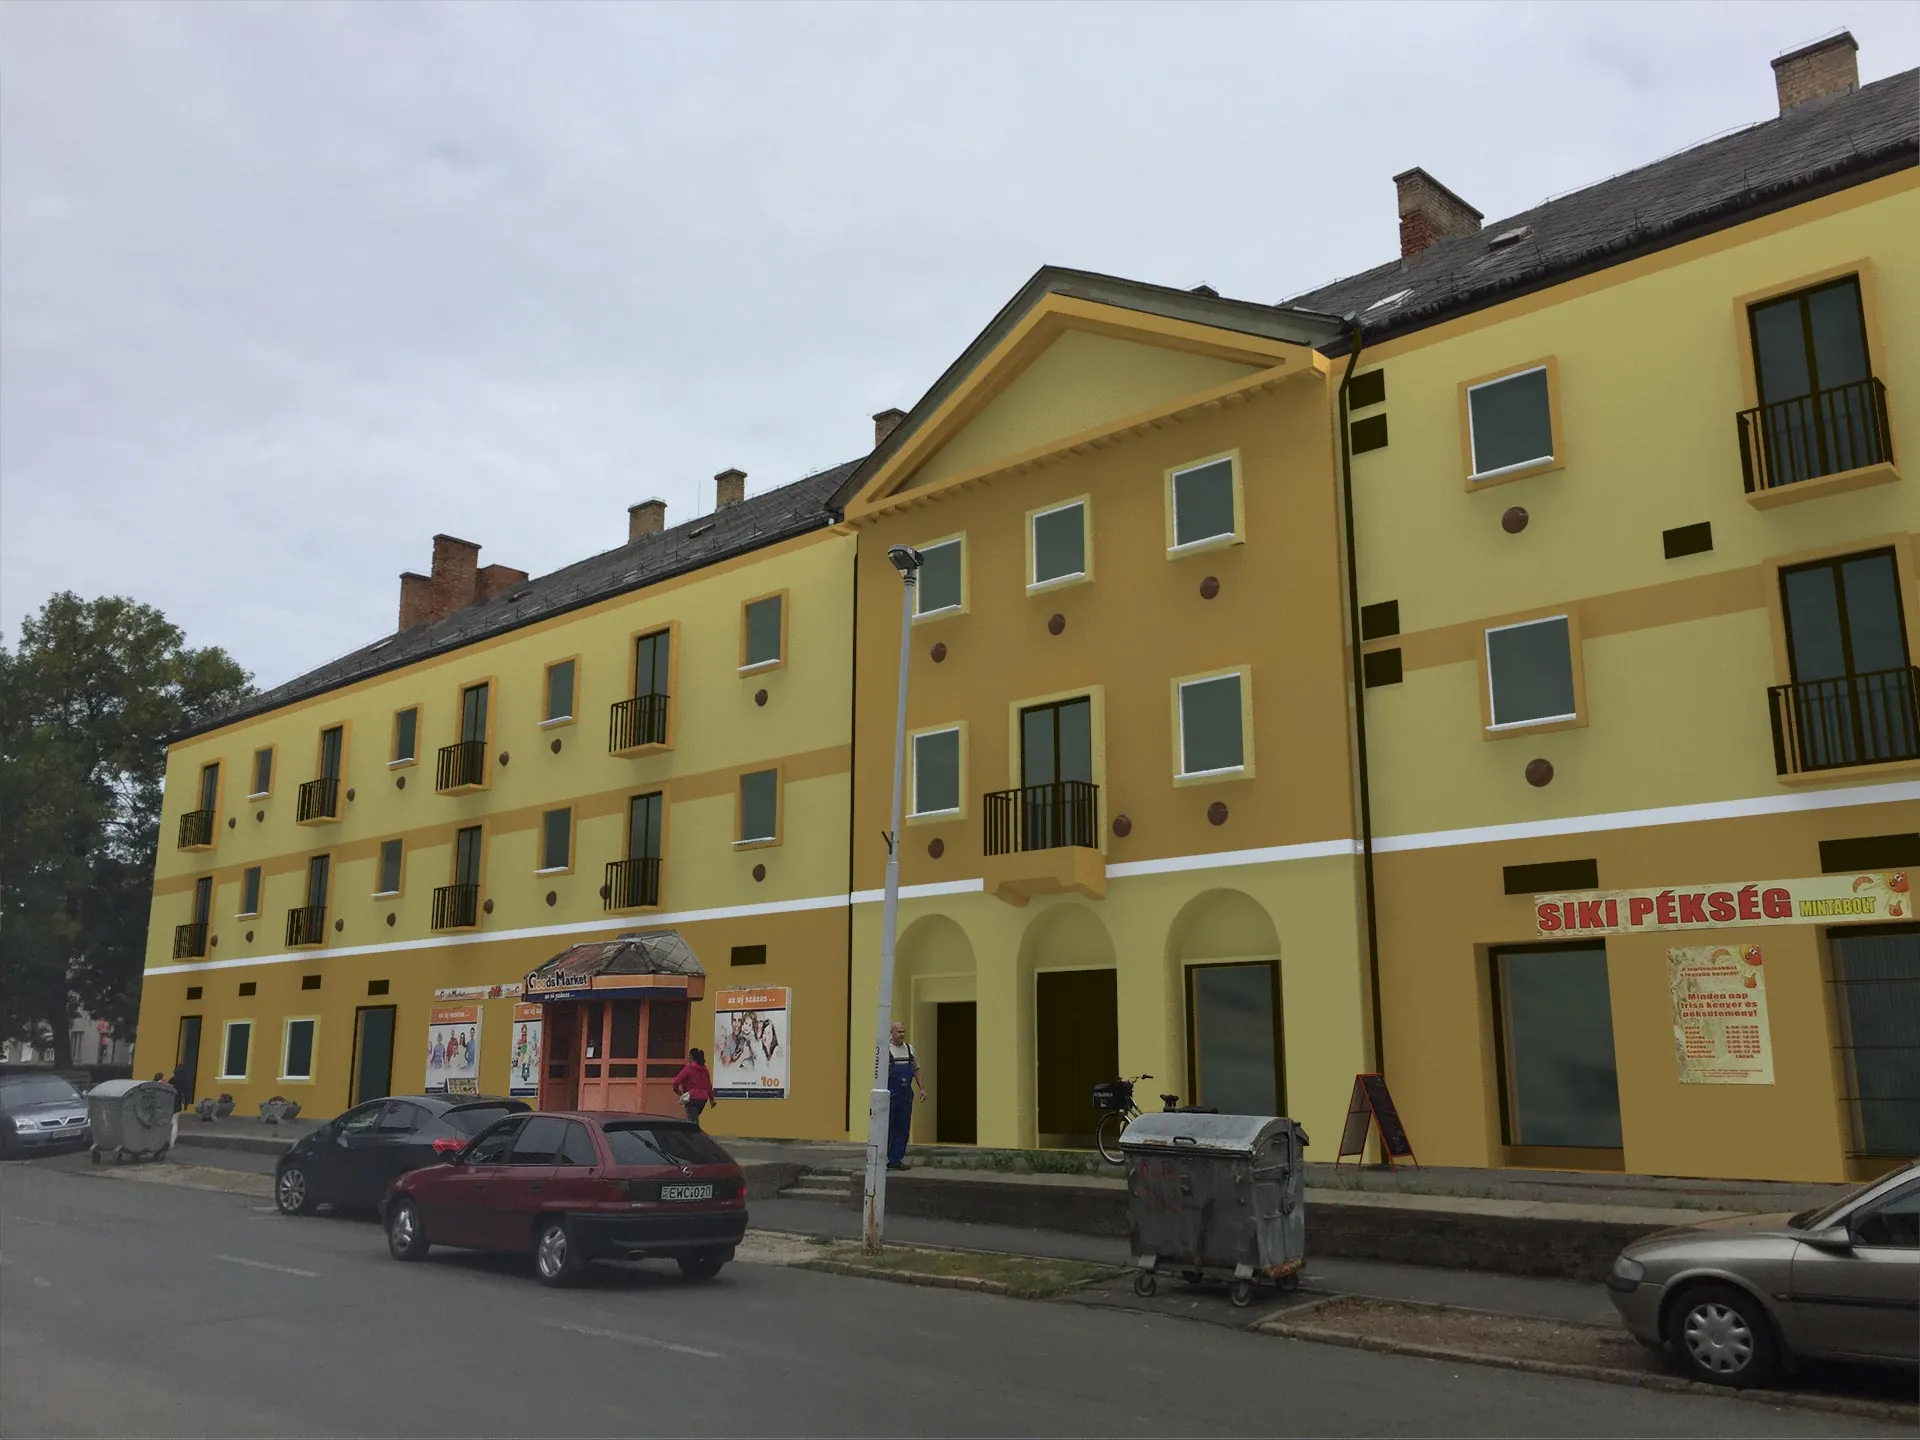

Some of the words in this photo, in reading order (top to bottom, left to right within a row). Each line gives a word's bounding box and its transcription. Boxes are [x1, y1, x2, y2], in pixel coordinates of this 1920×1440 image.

[1537, 899, 1618, 932] SIKI
[1629, 884, 1793, 926] PÉKSÉG
[1799, 896, 1876, 917] MINTABOLT
